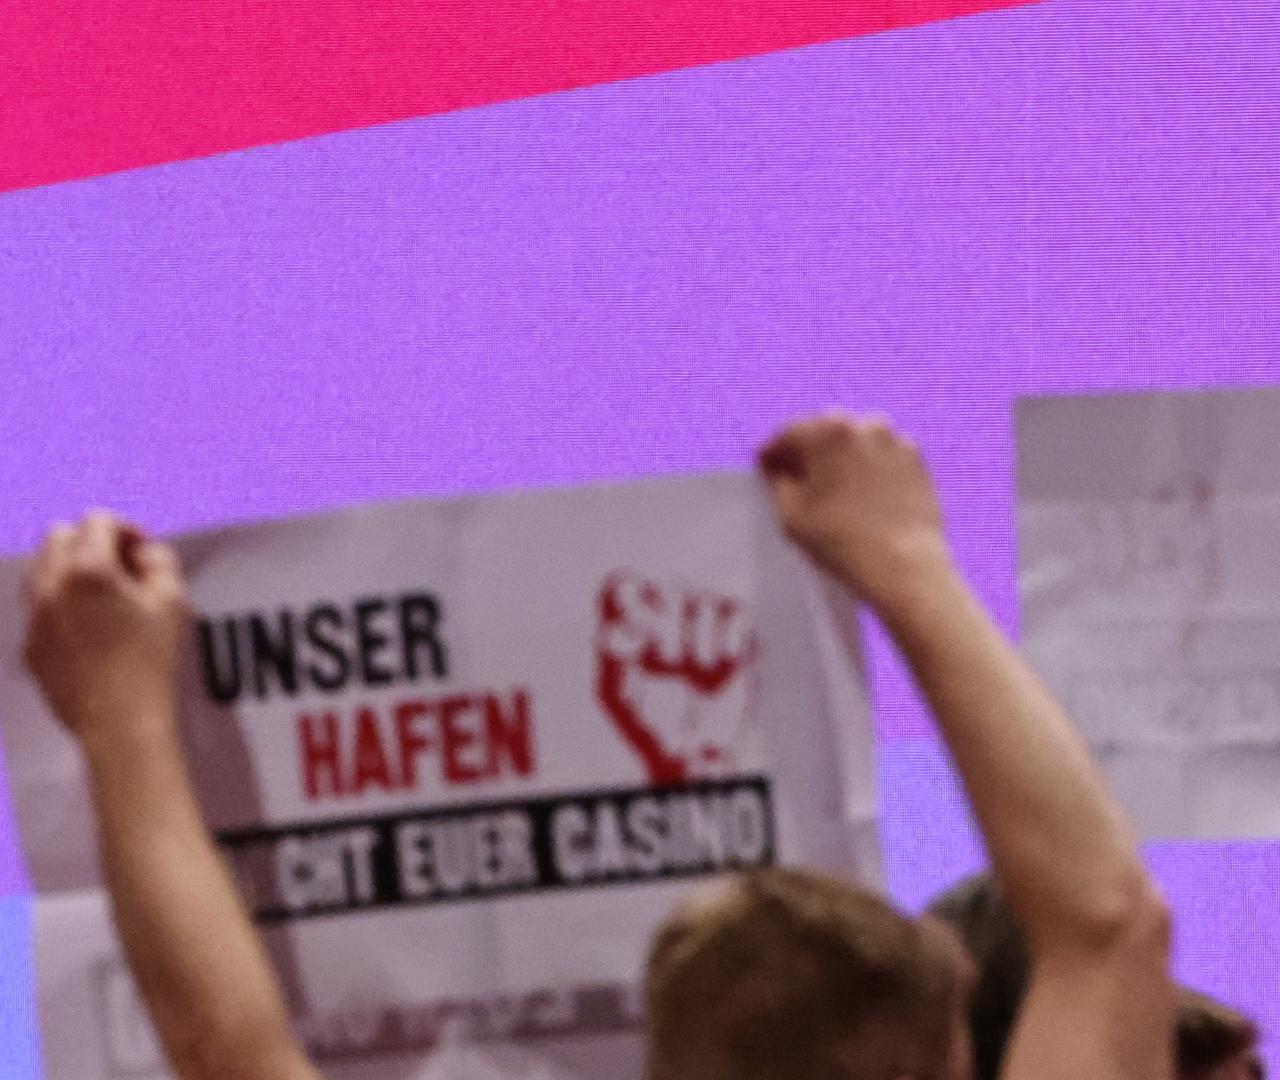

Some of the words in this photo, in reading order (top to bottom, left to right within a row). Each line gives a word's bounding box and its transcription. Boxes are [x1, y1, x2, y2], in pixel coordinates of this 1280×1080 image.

[200, 590, 448, 704] UNSER
[298, 688, 538, 804] HAFEN
[274, 824, 377, 908] CHT
[400, 808, 542, 898] EUER
[551, 784, 768, 882] CASINO
